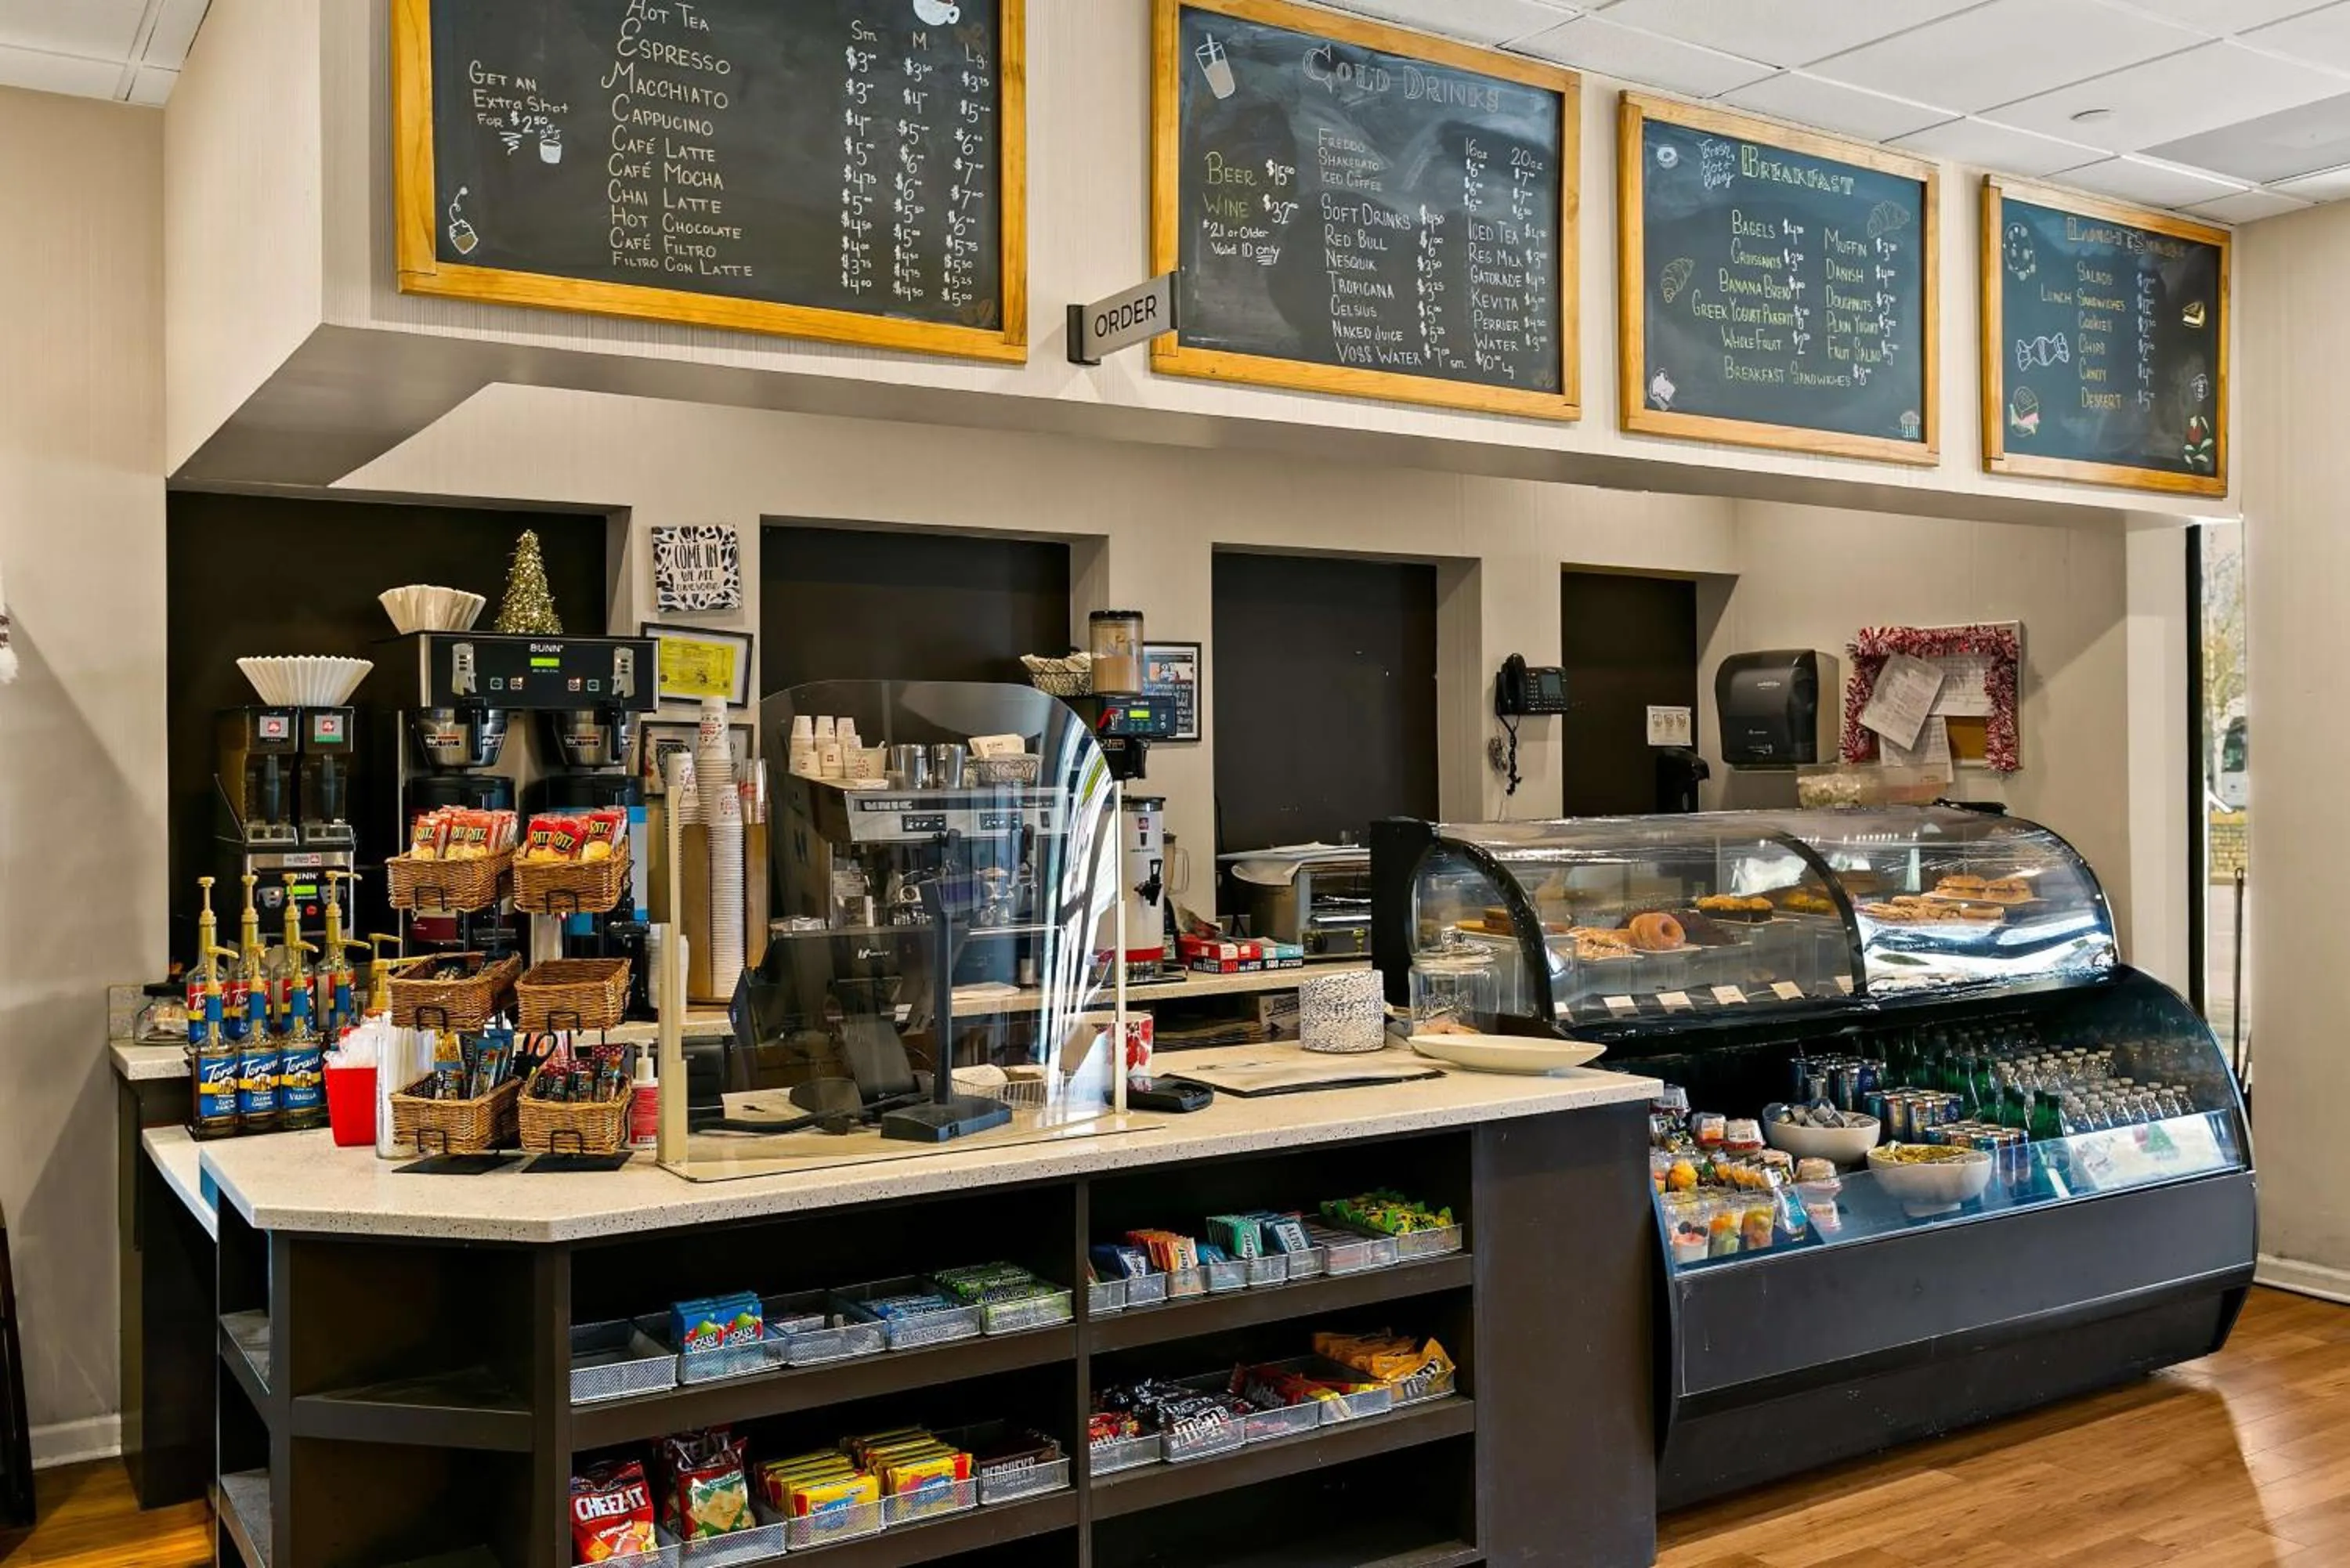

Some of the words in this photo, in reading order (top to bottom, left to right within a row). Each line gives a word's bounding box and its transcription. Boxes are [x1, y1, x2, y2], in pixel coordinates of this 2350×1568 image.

[617, 17, 731, 74] ESPRESSO
[469, 60, 507, 85] GET
[515, 76, 537, 92] AN
[601, 62, 729, 109] MACCHIATO
[1094, 294, 1157, 338] ORDER
